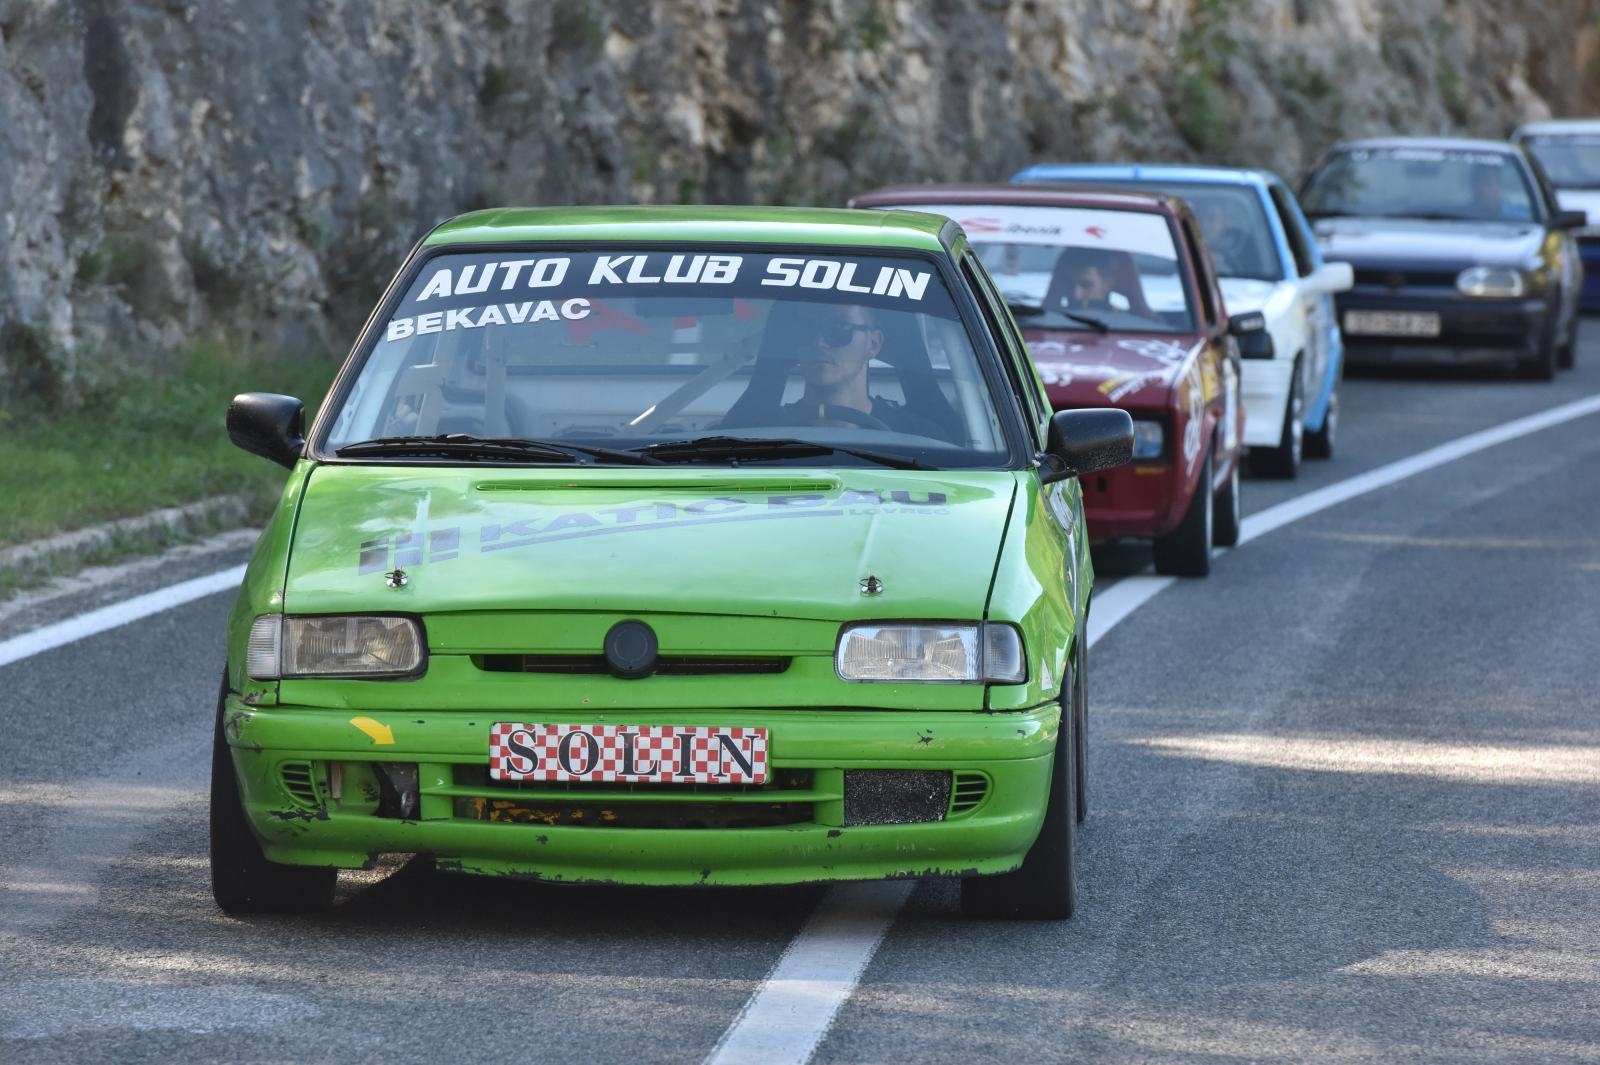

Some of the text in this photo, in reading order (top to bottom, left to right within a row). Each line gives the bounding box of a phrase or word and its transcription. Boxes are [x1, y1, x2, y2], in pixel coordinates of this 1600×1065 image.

[416, 255, 931, 302] AUTO KLUB SOLIN
[387, 298, 591, 342] BEKAVAC
[506, 729, 759, 778] SOLIN
